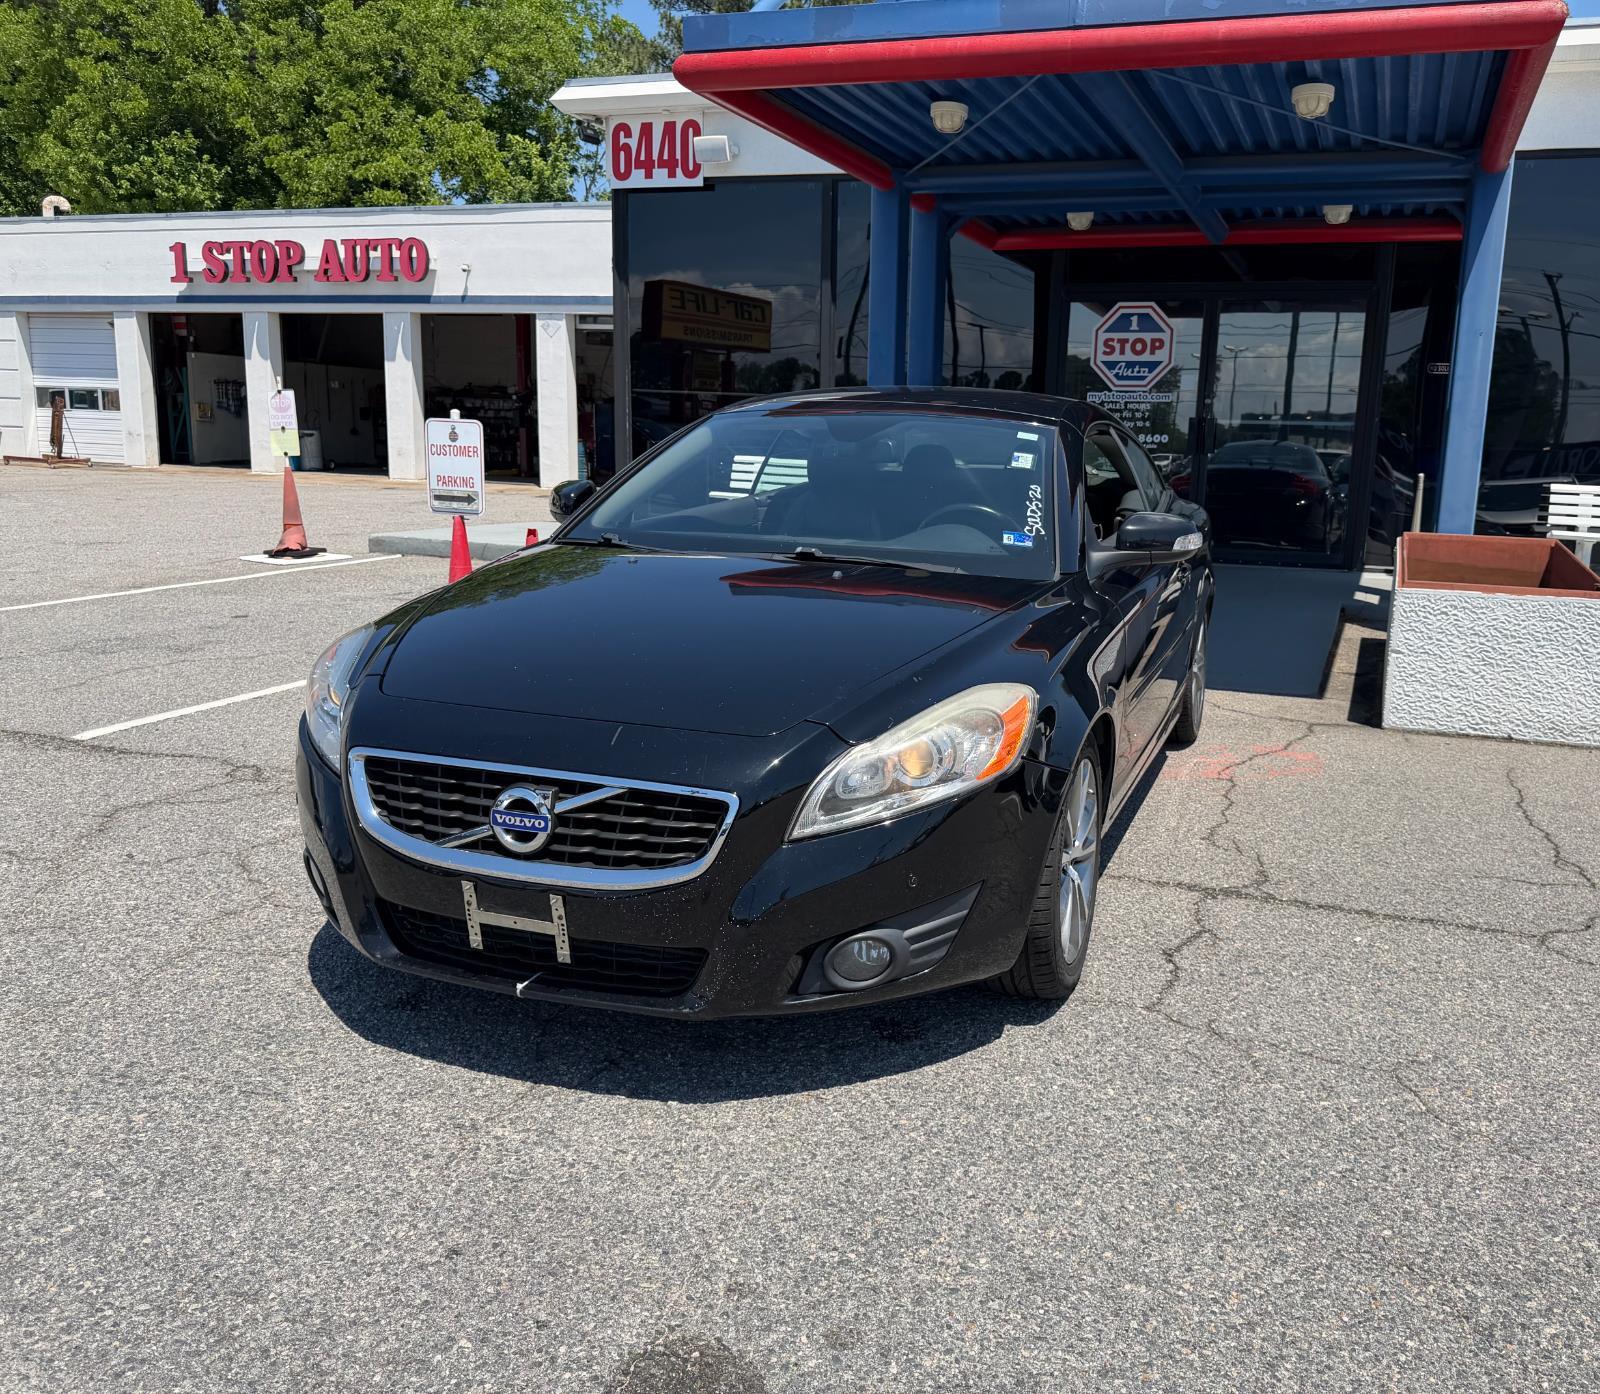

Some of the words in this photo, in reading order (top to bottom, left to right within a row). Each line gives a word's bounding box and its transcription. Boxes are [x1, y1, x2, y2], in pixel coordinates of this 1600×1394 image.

[611, 118, 702, 181] 6440
[168, 241, 194, 284] 1
[201, 239, 306, 284] STOP
[314, 237, 430, 283] AUTO
[1129, 315, 1139, 330] 1
[1102, 337, 1165, 356] STOP
[1110, 362, 1153, 377] Auto
[1087, 391, 1172, 403] my1stopauto.com
[1104, 402, 1125, 410] SALES
[1127, 402, 1151, 411] HOURS
[430, 443, 479, 458] CUSTOMER
[436, 475, 475, 489] PARKING
[495, 813, 545, 829] VOLVO
